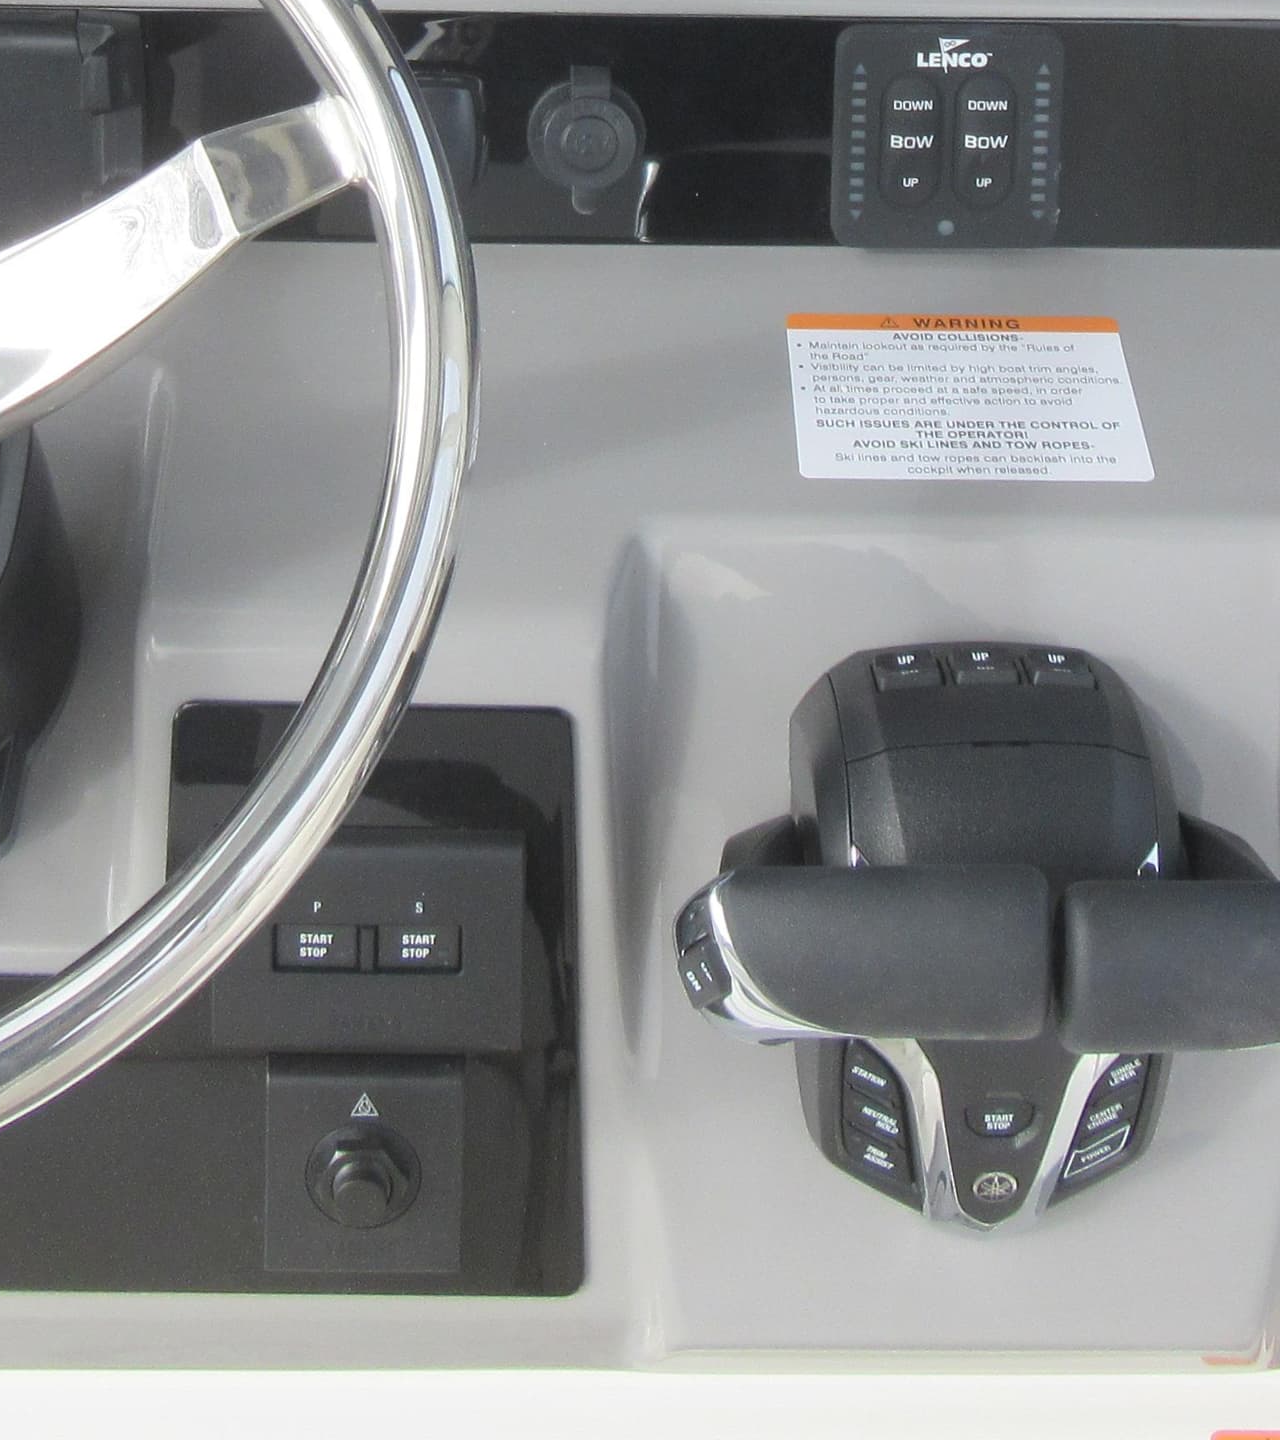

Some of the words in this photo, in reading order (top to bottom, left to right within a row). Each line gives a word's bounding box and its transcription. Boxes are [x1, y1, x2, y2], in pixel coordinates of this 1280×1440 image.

[917, 52, 988, 69] LENCO
[893, 100, 933, 111] DOWN
[968, 100, 1008, 111] DOWN
[890, 134, 934, 149] BOW
[964, 134, 1009, 149] BOW
[903, 177, 920, 188] UP
[976, 177, 992, 188] UP
[913, 318, 1020, 330] WARNING
[893, 332, 934, 341] AVOID
[809, 341, 859, 350] Maintain
[862, 342, 907, 351] lookout
[928, 343, 977, 354] required
[982, 344, 995, 353] by
[999, 344, 1018, 352] the
[1063, 344, 1075, 352] of
[811, 363, 859, 373] Visibility
[863, 364, 885, 372] can
[889, 363, 904, 372] be
[907, 363, 948, 372] limited
[951, 364, 966, 374] by
[969, 364, 996, 375] high
[999, 365, 1025, 373] boat
[1029, 365, 1052, 374] trim
[901, 375, 948, 383] weather
[953, 375, 976, 383] and
[980, 376, 1054, 385] atmospheric
[813, 384, 826, 392] At
[846, 384, 879, 393] times
[883, 385, 933, 395] proceed
[936, 385, 948, 394] at
[963, 386, 988, 394] safe
[1036, 386, 1047, 395] in
[1050, 387, 1083, 395] order
[814, 396, 826, 404] to
[830, 395, 856, 404] take
[859, 397, 900, 406] proper
[904, 396, 927, 405] and
[930, 396, 980, 405] effective
[984, 397, 1021, 406] action
[1024, 398, 1037, 406] to
[1040, 398, 1073, 406] avoid
[815, 406, 880, 415] hazardous
[816, 419, 855, 428] SUCH
[859, 420, 910, 429] ISSUES
[914, 420, 943, 429] ARE
[946, 420, 995, 429] UNDER
[998, 421, 1026, 429] THE
[1030, 421, 1098, 430] CONTROL
[1101, 421, 1120, 430] OF
[916, 430, 944, 439] THE
[853, 440, 896, 449] AVOID
[900, 440, 923, 449] SKI
[927, 440, 968, 449] LINES
[972, 440, 1002, 449] AND
[1005, 441, 1037, 449] TOW
[835, 452, 855, 462] Ski
[858, 452, 887, 462] lines
[891, 453, 914, 462] and
[918, 453, 940, 462] tow
[944, 454, 980, 464] ropes
[984, 455, 1007, 463] can
[1010, 454, 1066, 464] backlash
[1070, 455, 1093, 464] into
[1097, 456, 1117, 464] the
[907, 465, 953, 475] cockpit
[956, 465, 990, 474] when
[896, 654, 915, 665] UP
[971, 651, 990, 662] UP
[1047, 653, 1066, 664] UP
[313, 901, 322, 913] P
[415, 901, 424, 914] S
[299, 933, 334, 945] START
[402, 934, 436, 946] START
[299, 946, 327, 958] STOP
[402, 947, 430, 959] STOP
[851, 1065, 887, 1087] STATION
[862, 1106, 898, 1126] NEUTRAL
[984, 1113, 1014, 1123] START
[986, 1121, 1011, 1131] STOP
